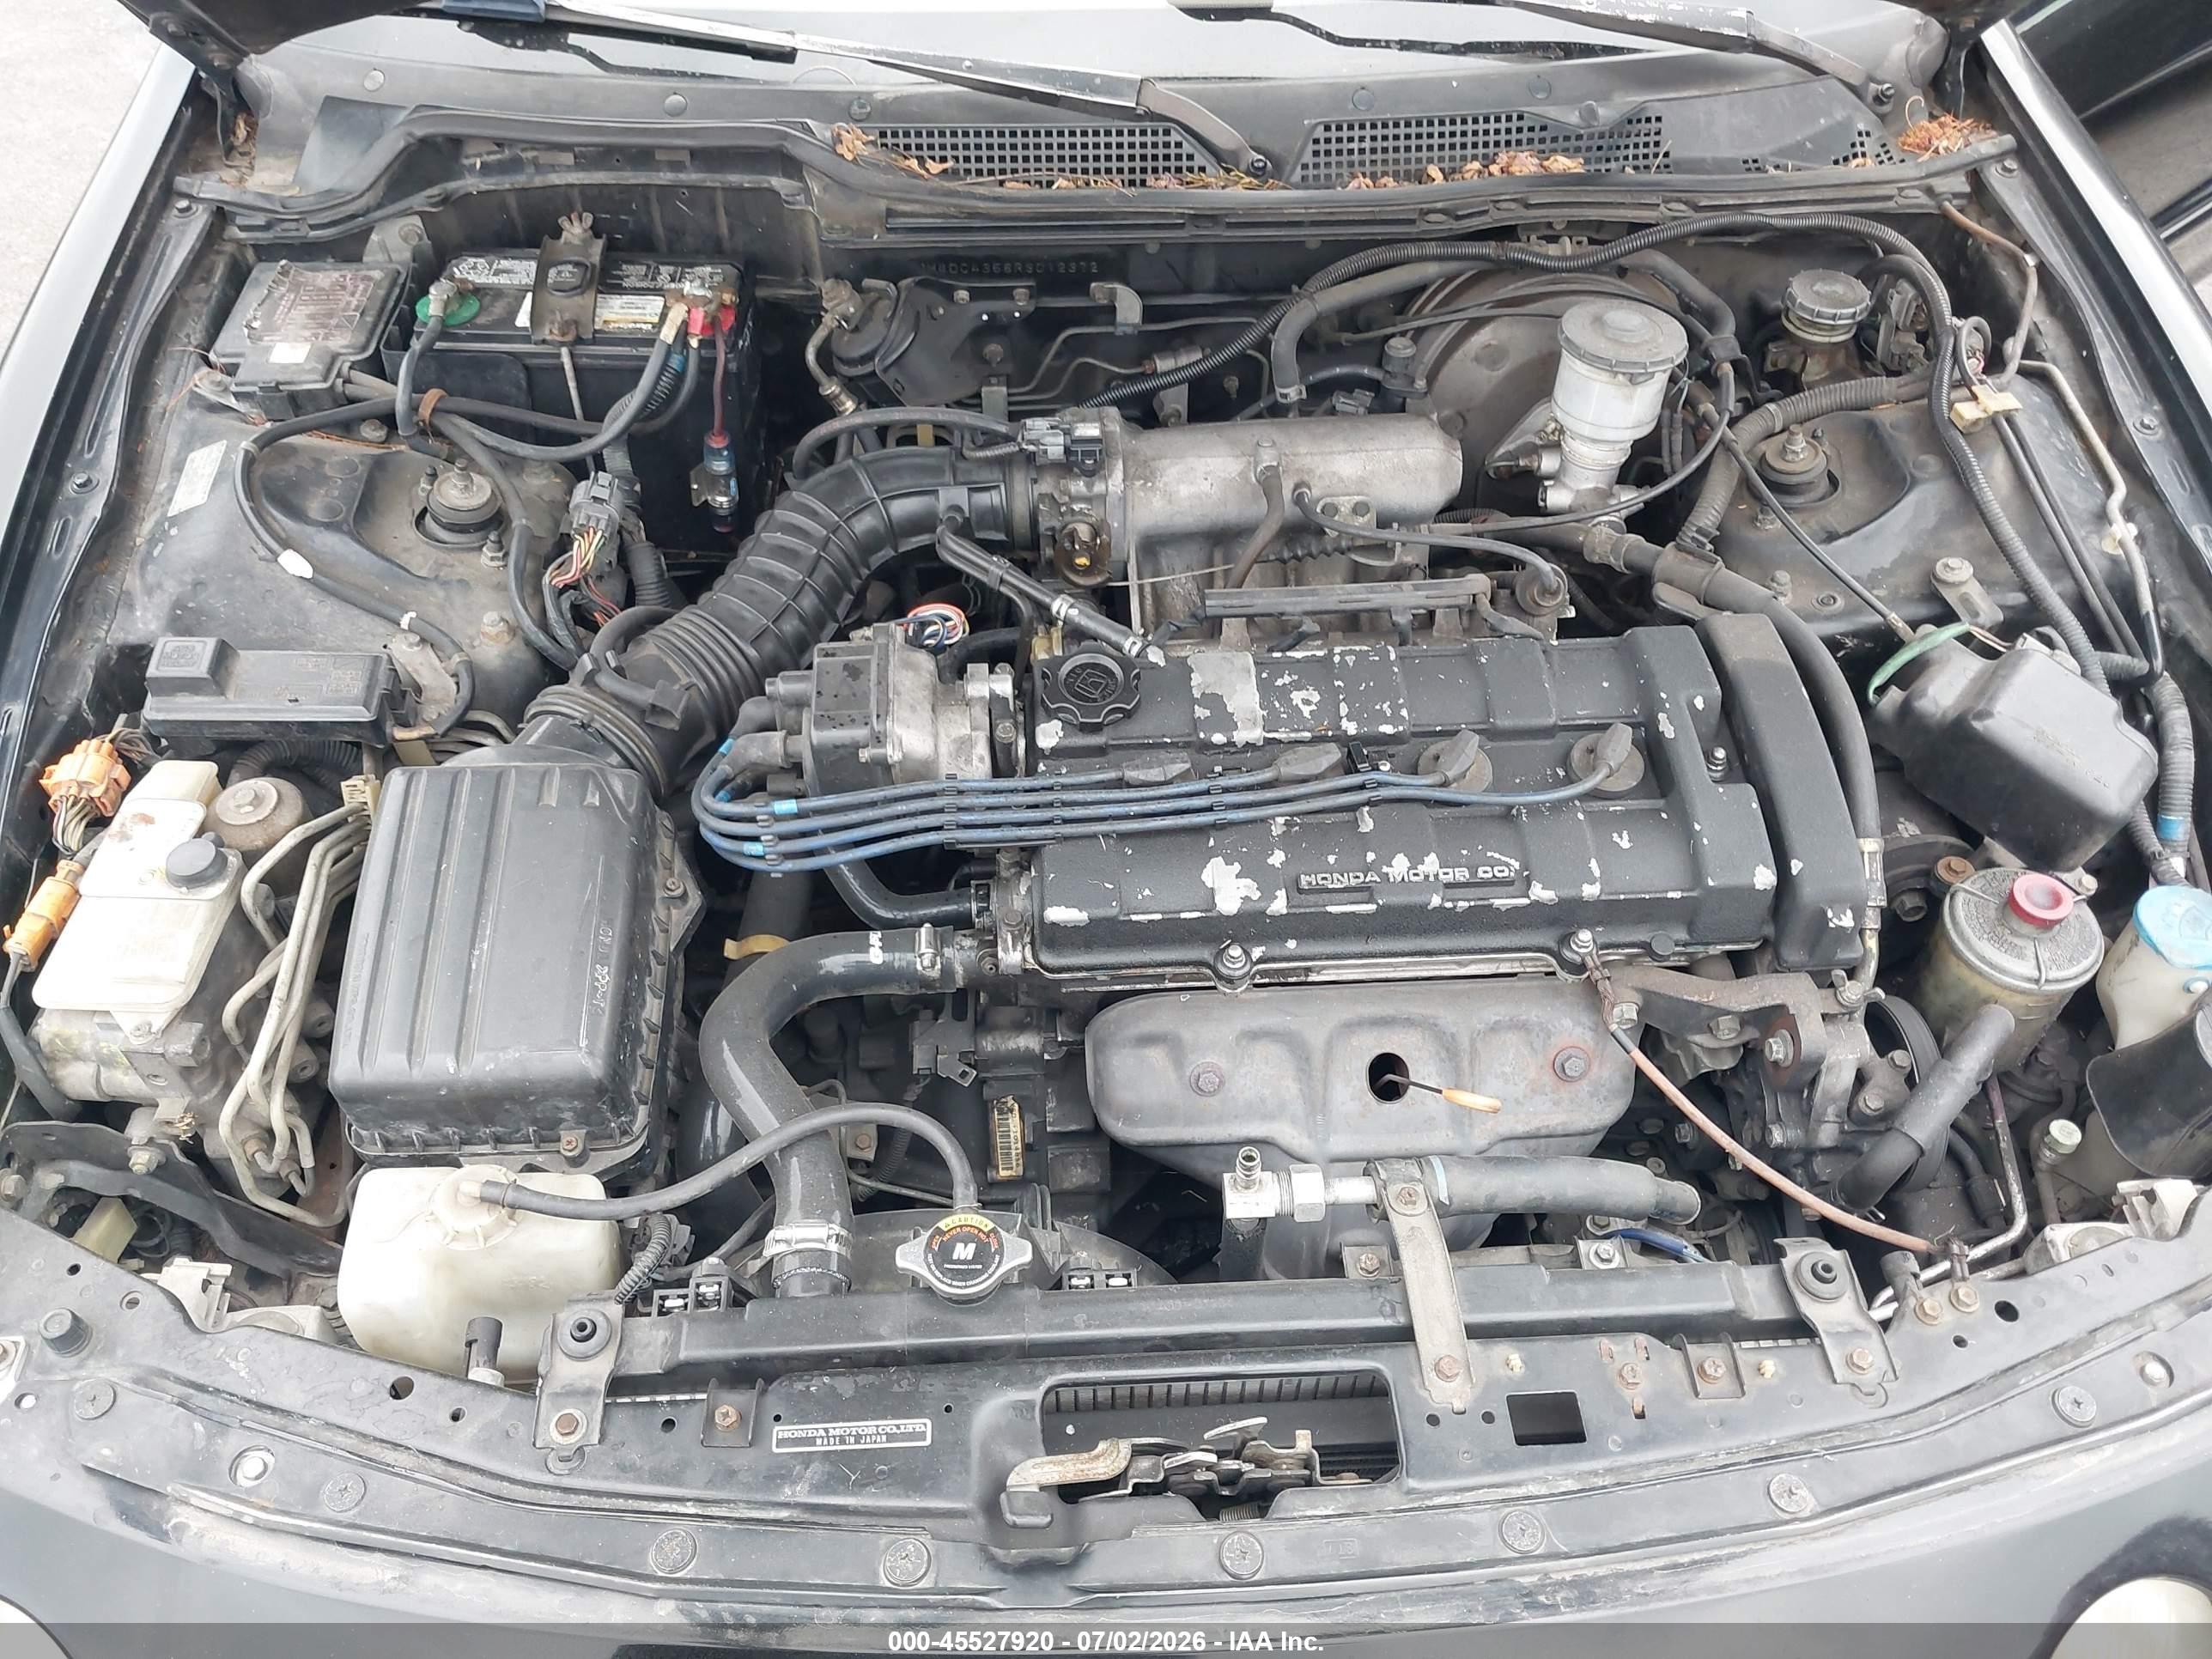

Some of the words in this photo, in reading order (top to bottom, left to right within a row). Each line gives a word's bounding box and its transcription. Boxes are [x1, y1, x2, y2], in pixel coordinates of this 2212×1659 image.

[1299, 871, 1382, 888] HONDA
[1385, 866, 1470, 884] MOTOR
[951, 1216, 988, 1228] CAUTION
[942, 1228, 961, 1243] NEVER
[961, 1226, 979, 1235] OPEN
[952, 1243, 977, 1261] M
[777, 1428, 827, 1439] HONDA
[828, 1425, 877, 1437] MOTOR
[816, 1437, 841, 1446] MADE
[846, 1436, 855, 1444] IN
[860, 1434, 887, 1443] JAPAN
